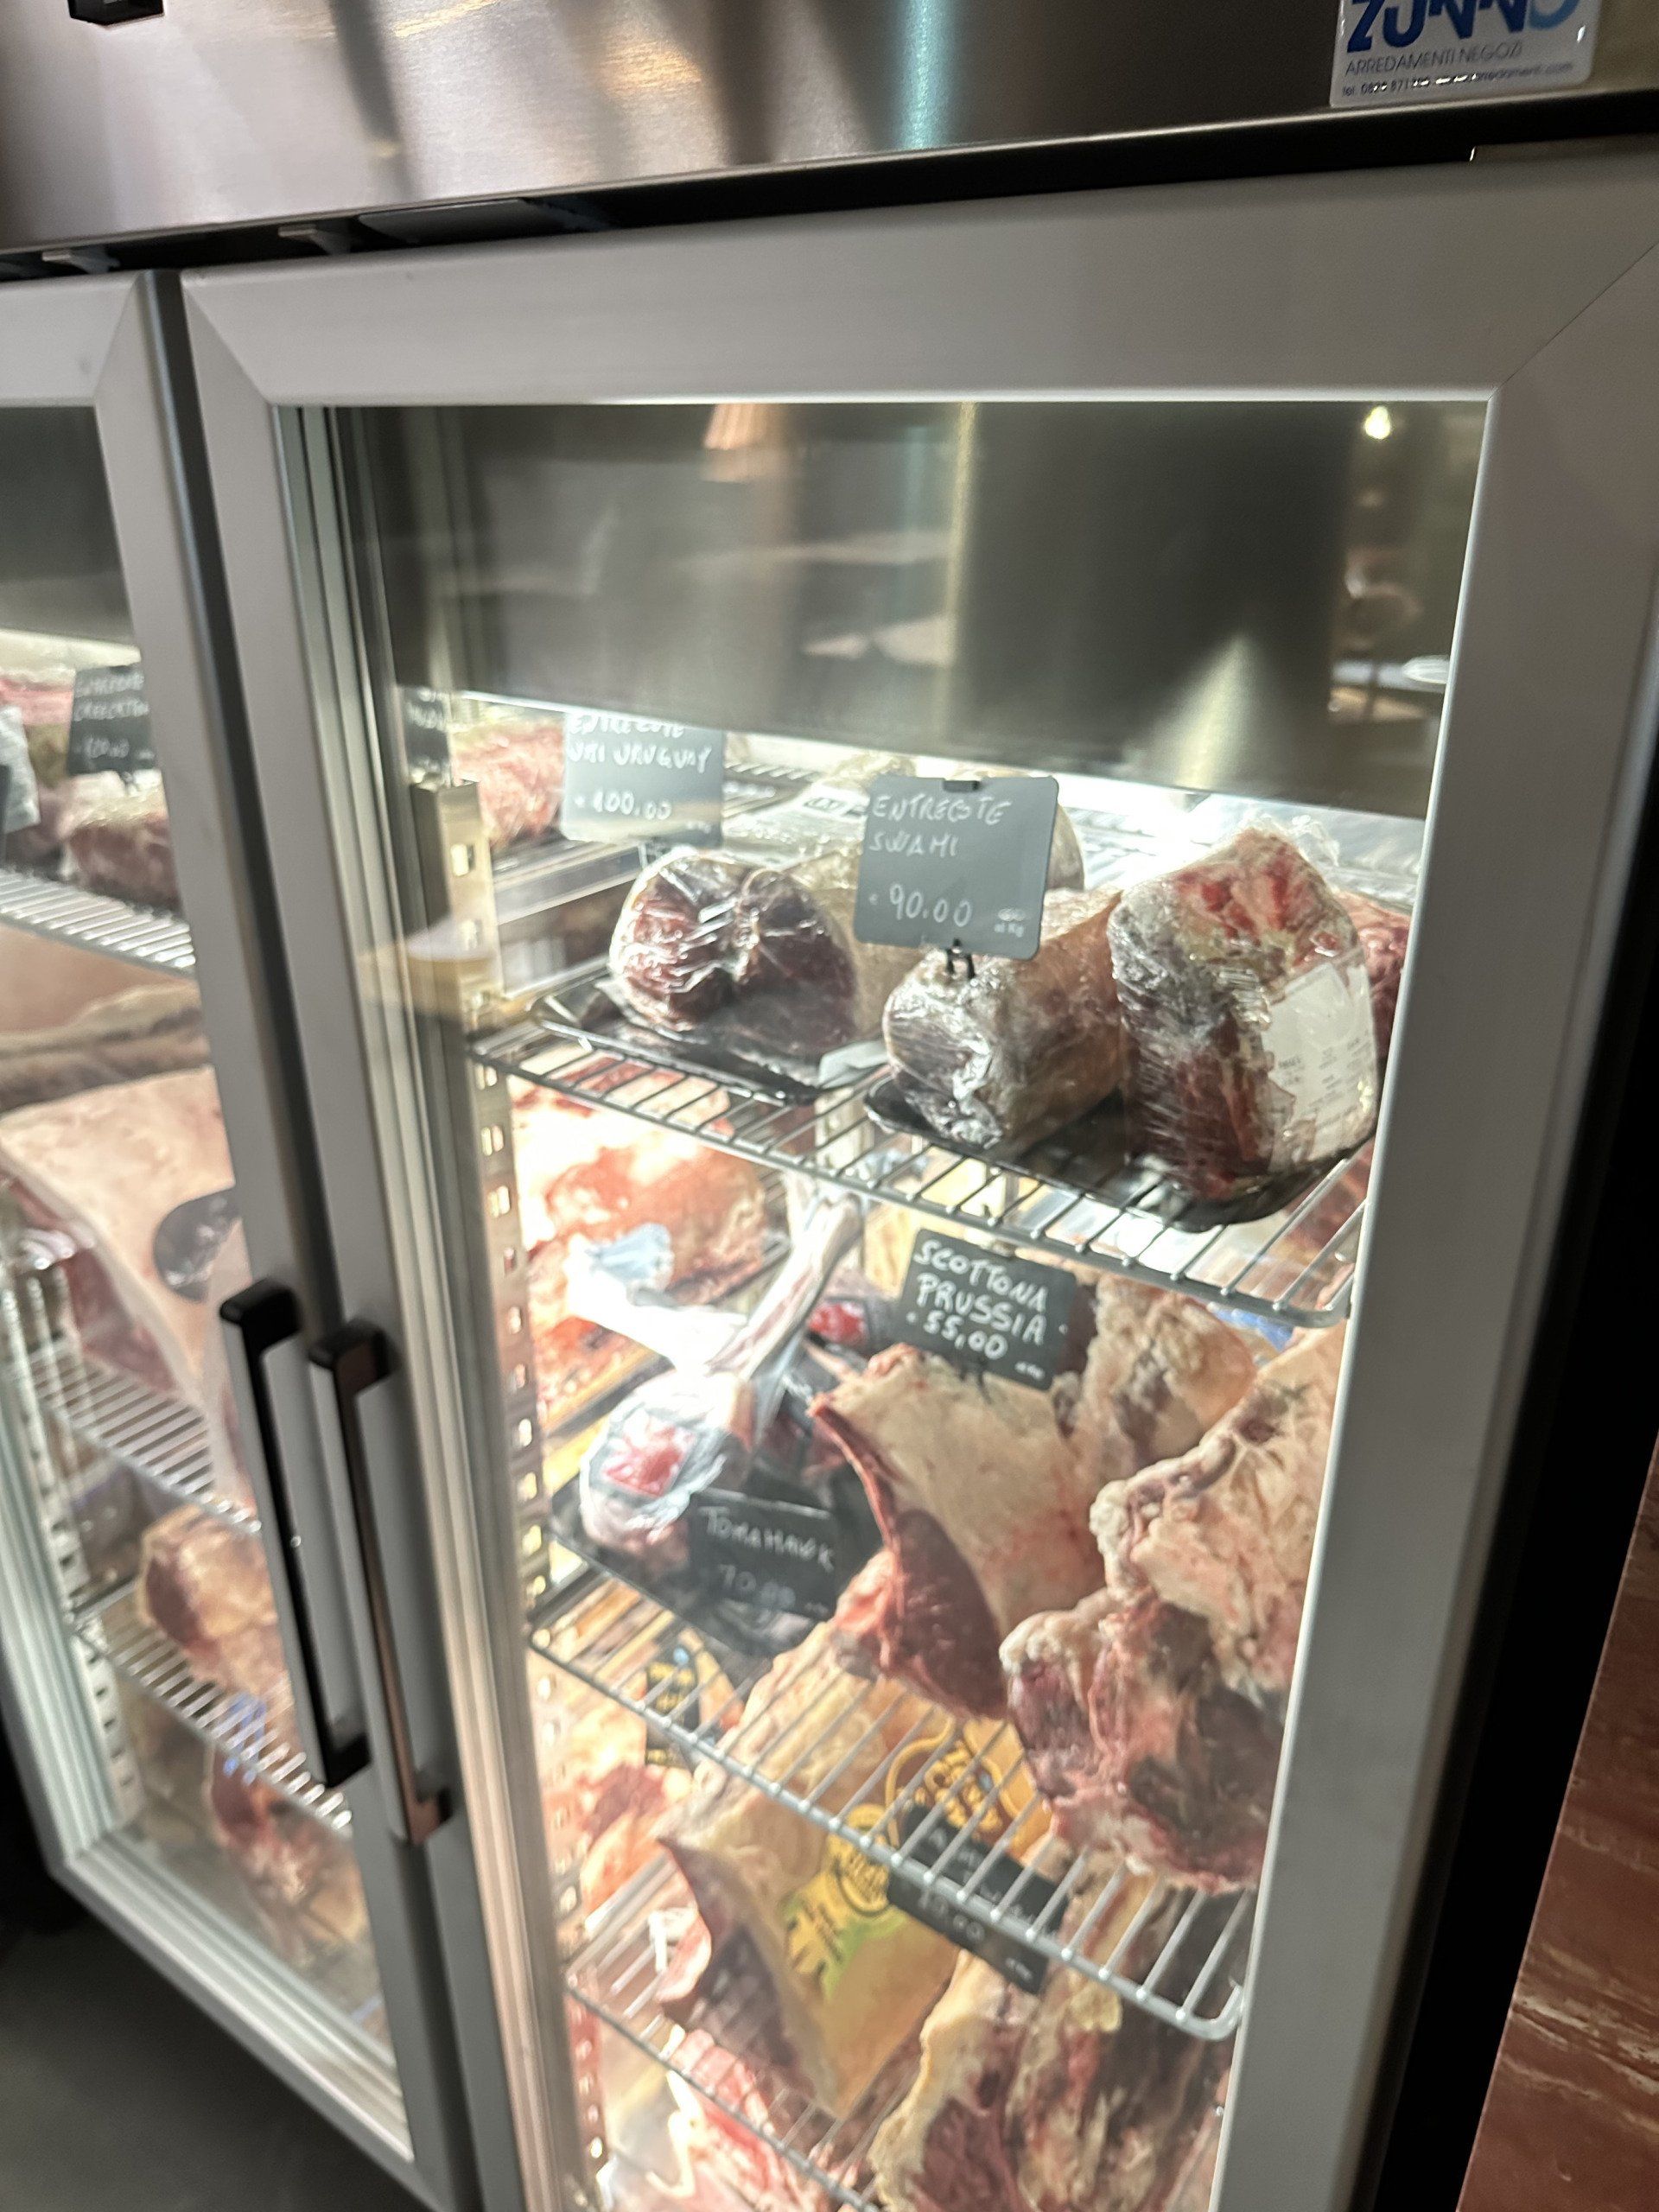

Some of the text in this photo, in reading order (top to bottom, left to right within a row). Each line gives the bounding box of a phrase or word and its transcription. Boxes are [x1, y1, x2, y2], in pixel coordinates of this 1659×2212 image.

[912, 1239, 1049, 1313] SCOTTONA
[916, 1272, 1047, 1345] PRUSSIA
[697, 1506, 835, 1573] TOMAHAWK
